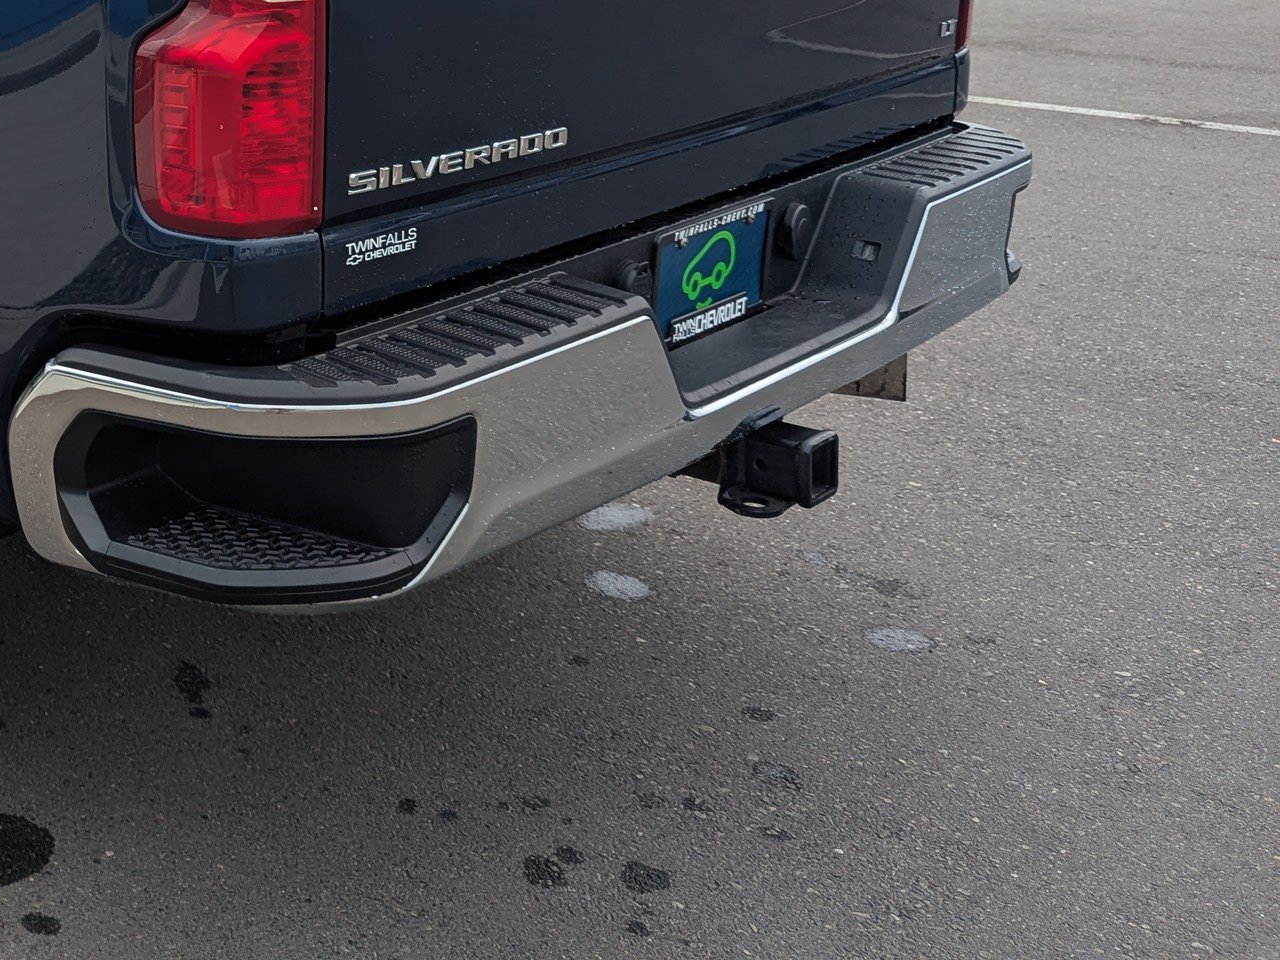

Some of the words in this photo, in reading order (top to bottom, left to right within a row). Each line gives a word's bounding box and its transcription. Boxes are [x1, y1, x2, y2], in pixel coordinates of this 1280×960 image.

[348, 127, 568, 195] SILVERADO
[365, 240, 417, 261] CHEVROLET
[695, 297, 748, 333] CHEVROLET
[673, 317, 696, 335] TWIN
[673, 326, 696, 343] FALLS
